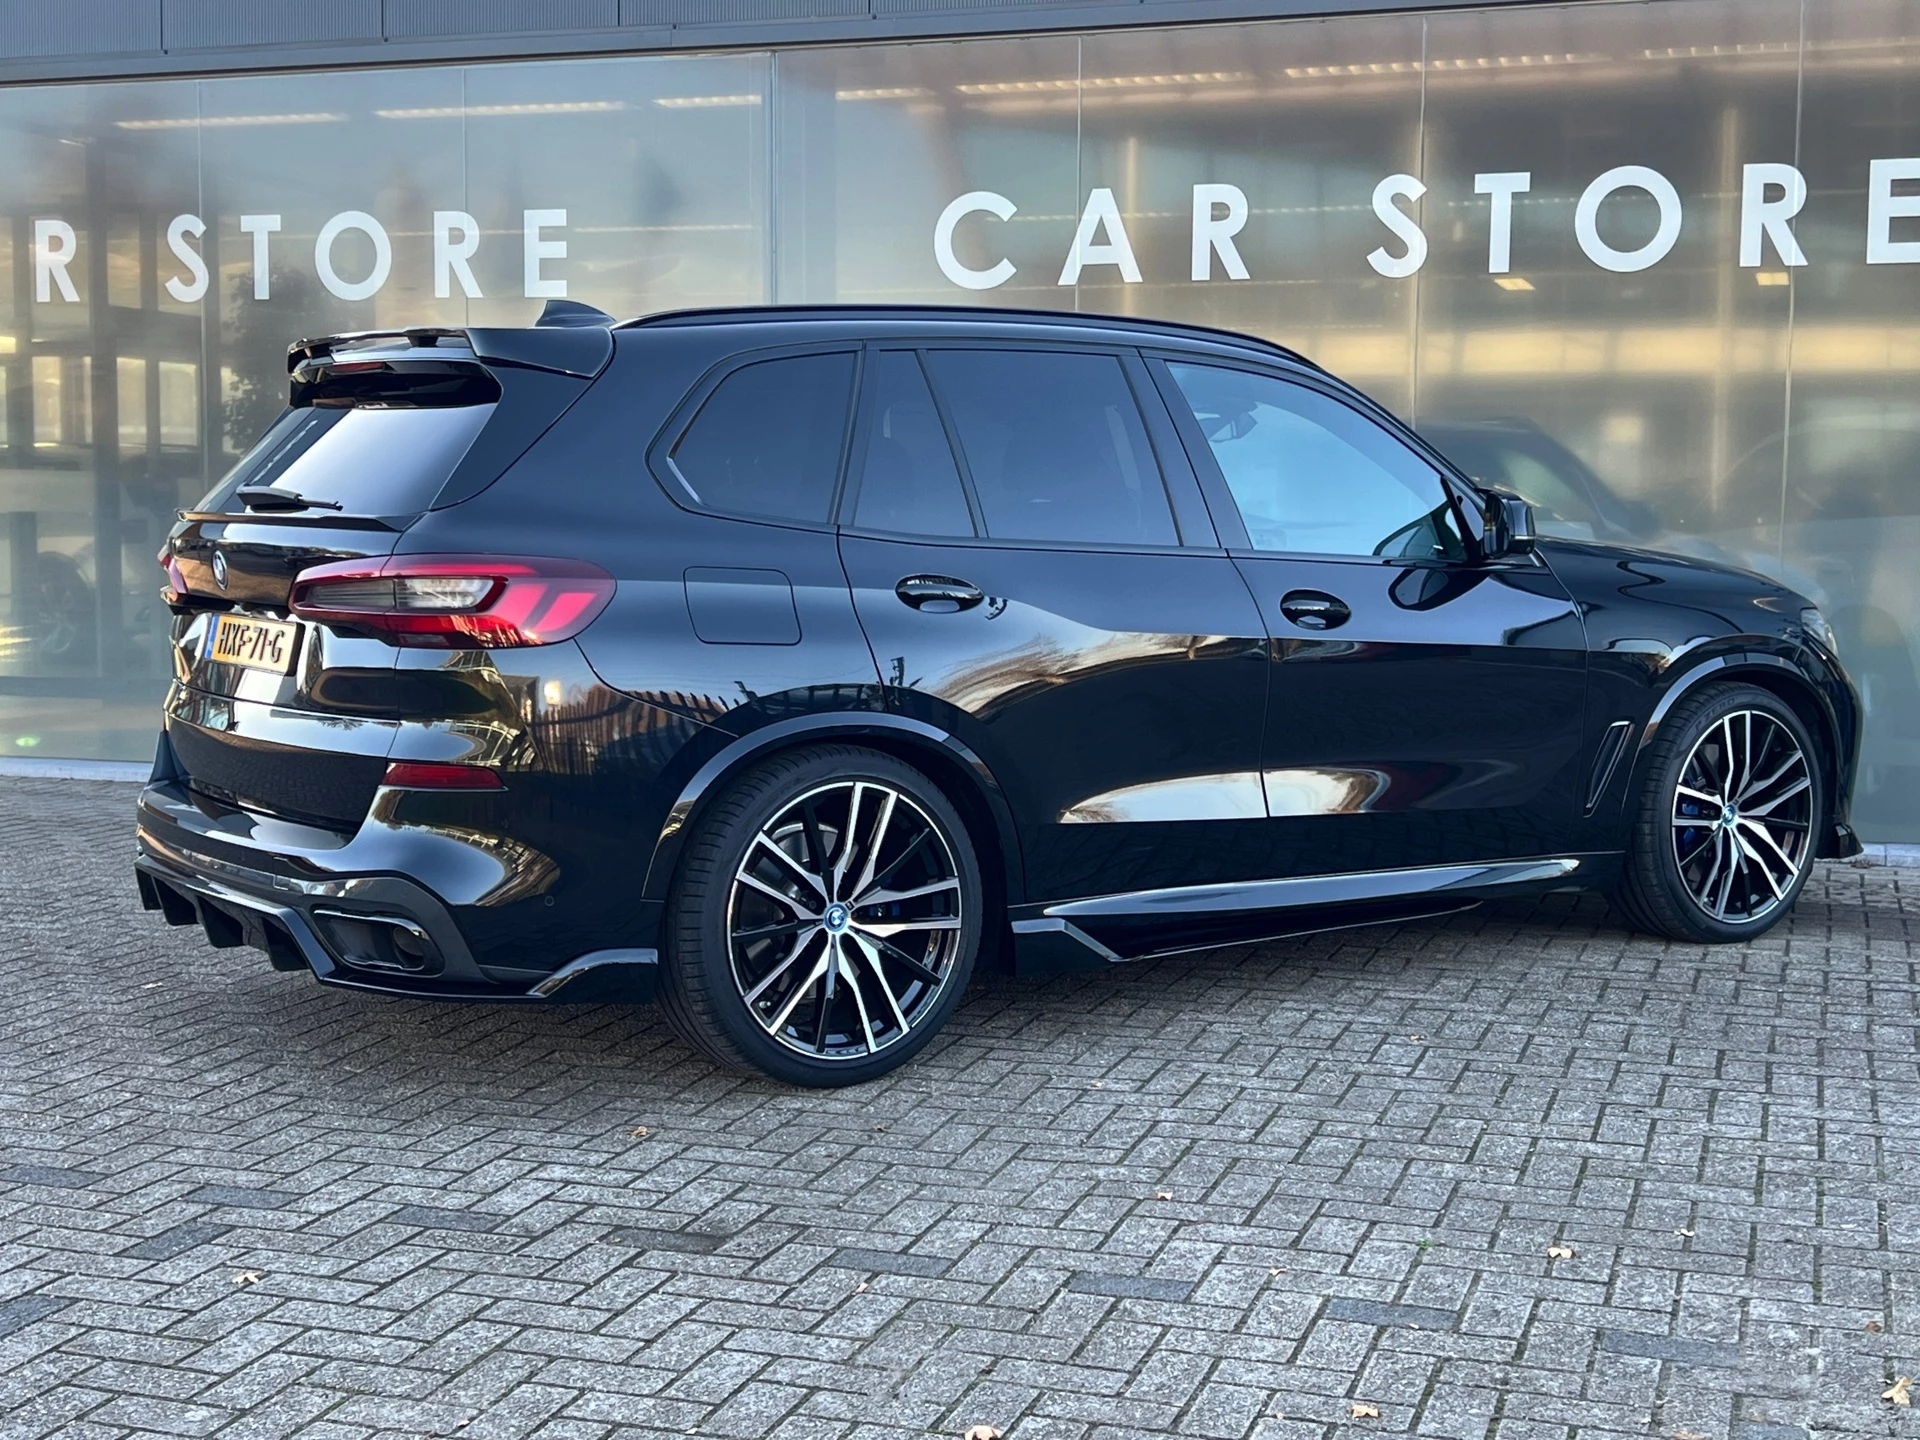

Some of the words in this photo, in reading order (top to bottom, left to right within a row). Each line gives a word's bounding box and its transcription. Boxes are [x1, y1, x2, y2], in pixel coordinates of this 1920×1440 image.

[165, 209, 569, 303] STORE
[933, 183, 1251, 290] CAR
[1366, 157, 1920, 279] STORE
[217, 621, 286, 664] HXF-71-G
